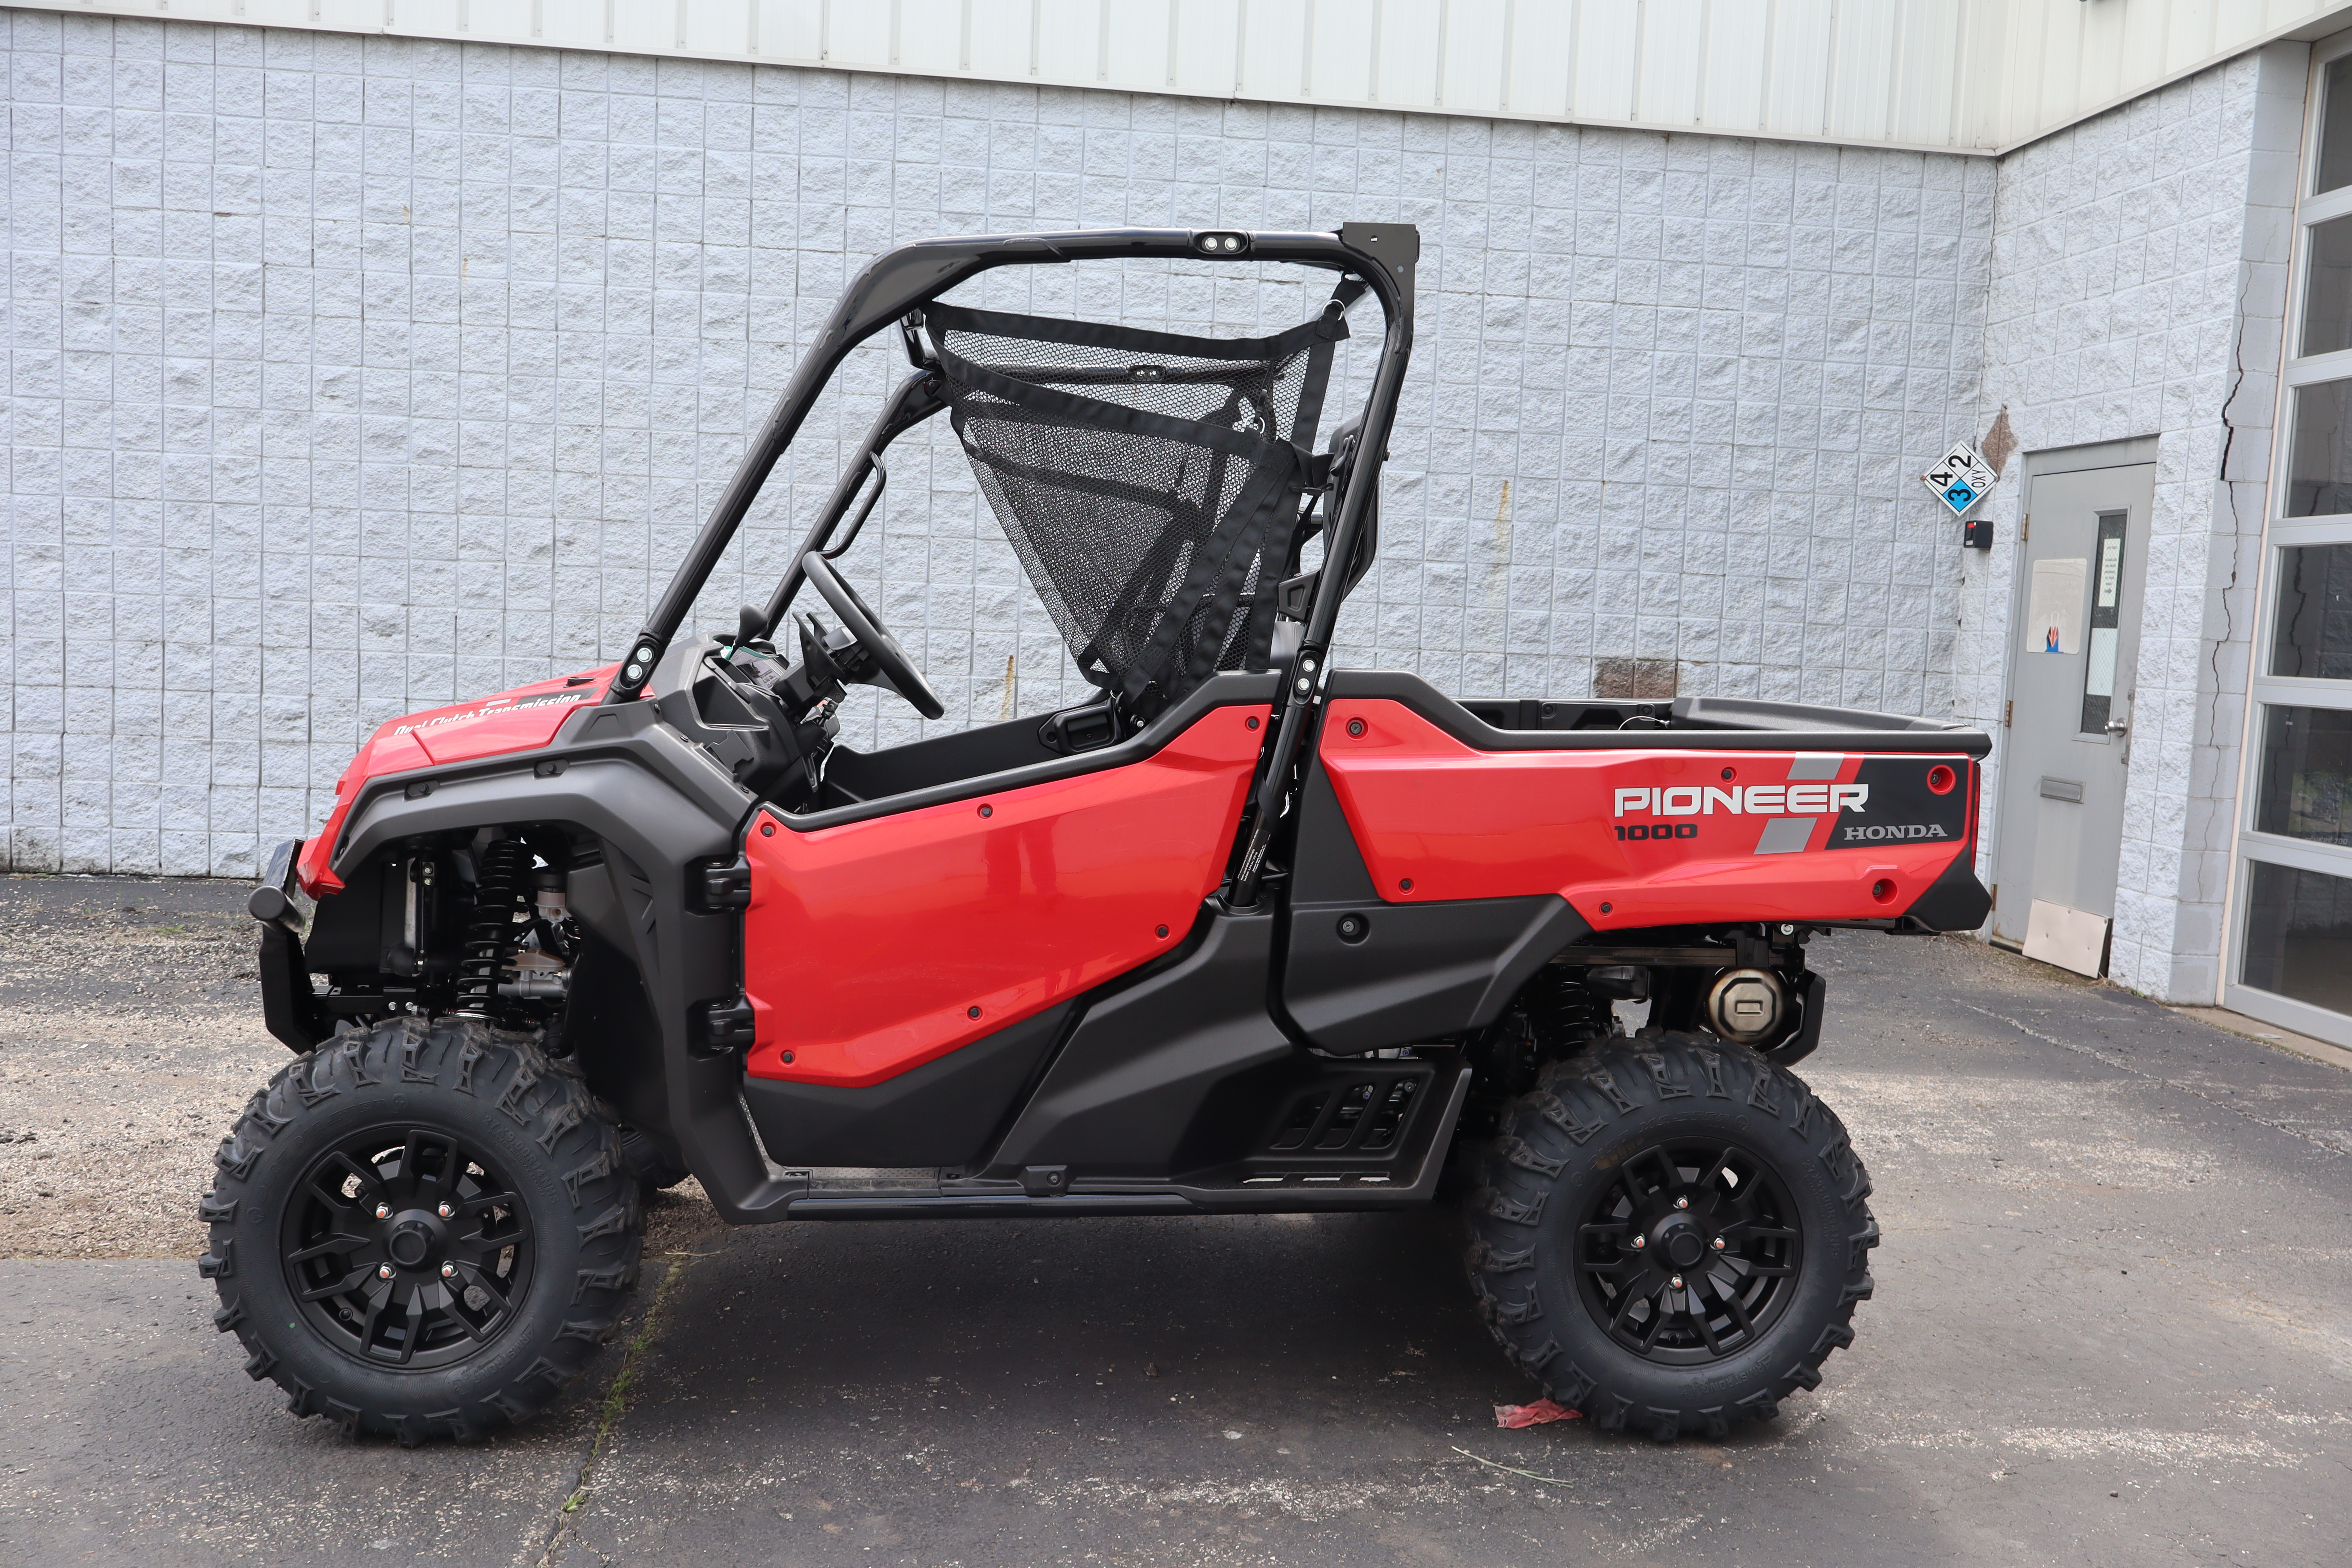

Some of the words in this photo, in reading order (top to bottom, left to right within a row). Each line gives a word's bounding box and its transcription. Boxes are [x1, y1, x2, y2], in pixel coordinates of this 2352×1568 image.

[1948, 456, 1971, 468] 2
[1930, 472, 1953, 486] 4
[1971, 469, 1985, 488] OXY
[1948, 489, 1971, 502] 3
[1614, 784, 1869, 817] PIONEER
[1614, 823, 1698, 841] 1000
[1844, 824, 1948, 840] HONDA
[1587, 1129, 1629, 1171] DIRT
[1637, 1111, 1730, 1133] MASTER
[256, 1149, 287, 1203] DIRT
[294, 1099, 385, 1149] MASTER
